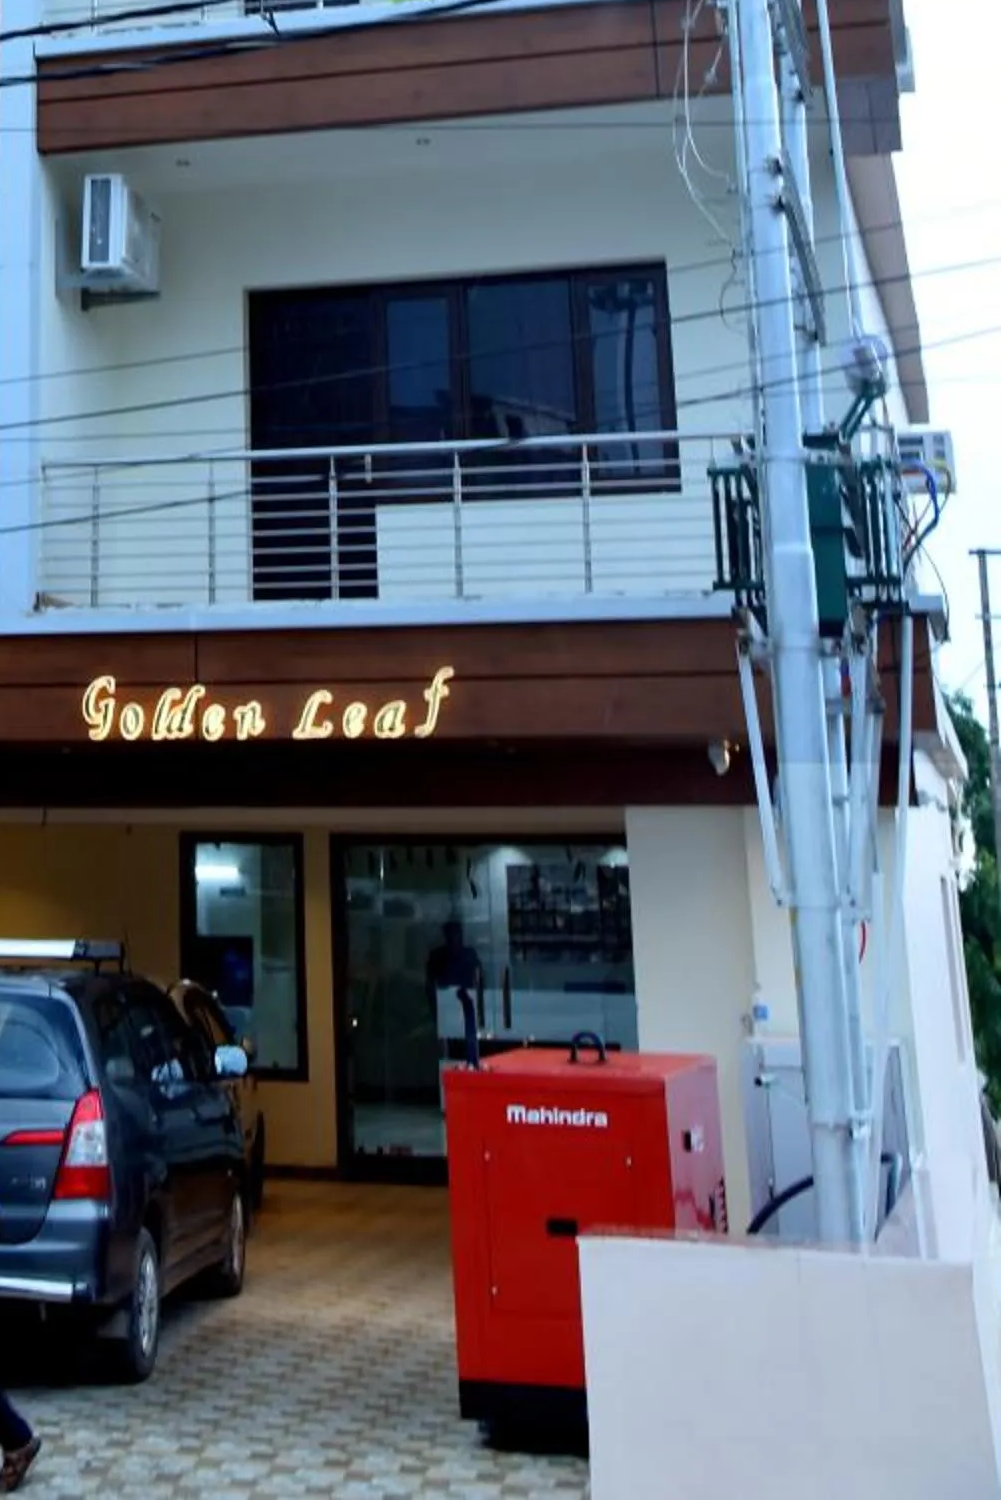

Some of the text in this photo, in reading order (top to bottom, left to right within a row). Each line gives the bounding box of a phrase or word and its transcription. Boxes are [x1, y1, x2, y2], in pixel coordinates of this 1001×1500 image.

[82, 666, 455, 742] Golden Leaf
[506, 1104, 608, 1129] Mahindra
